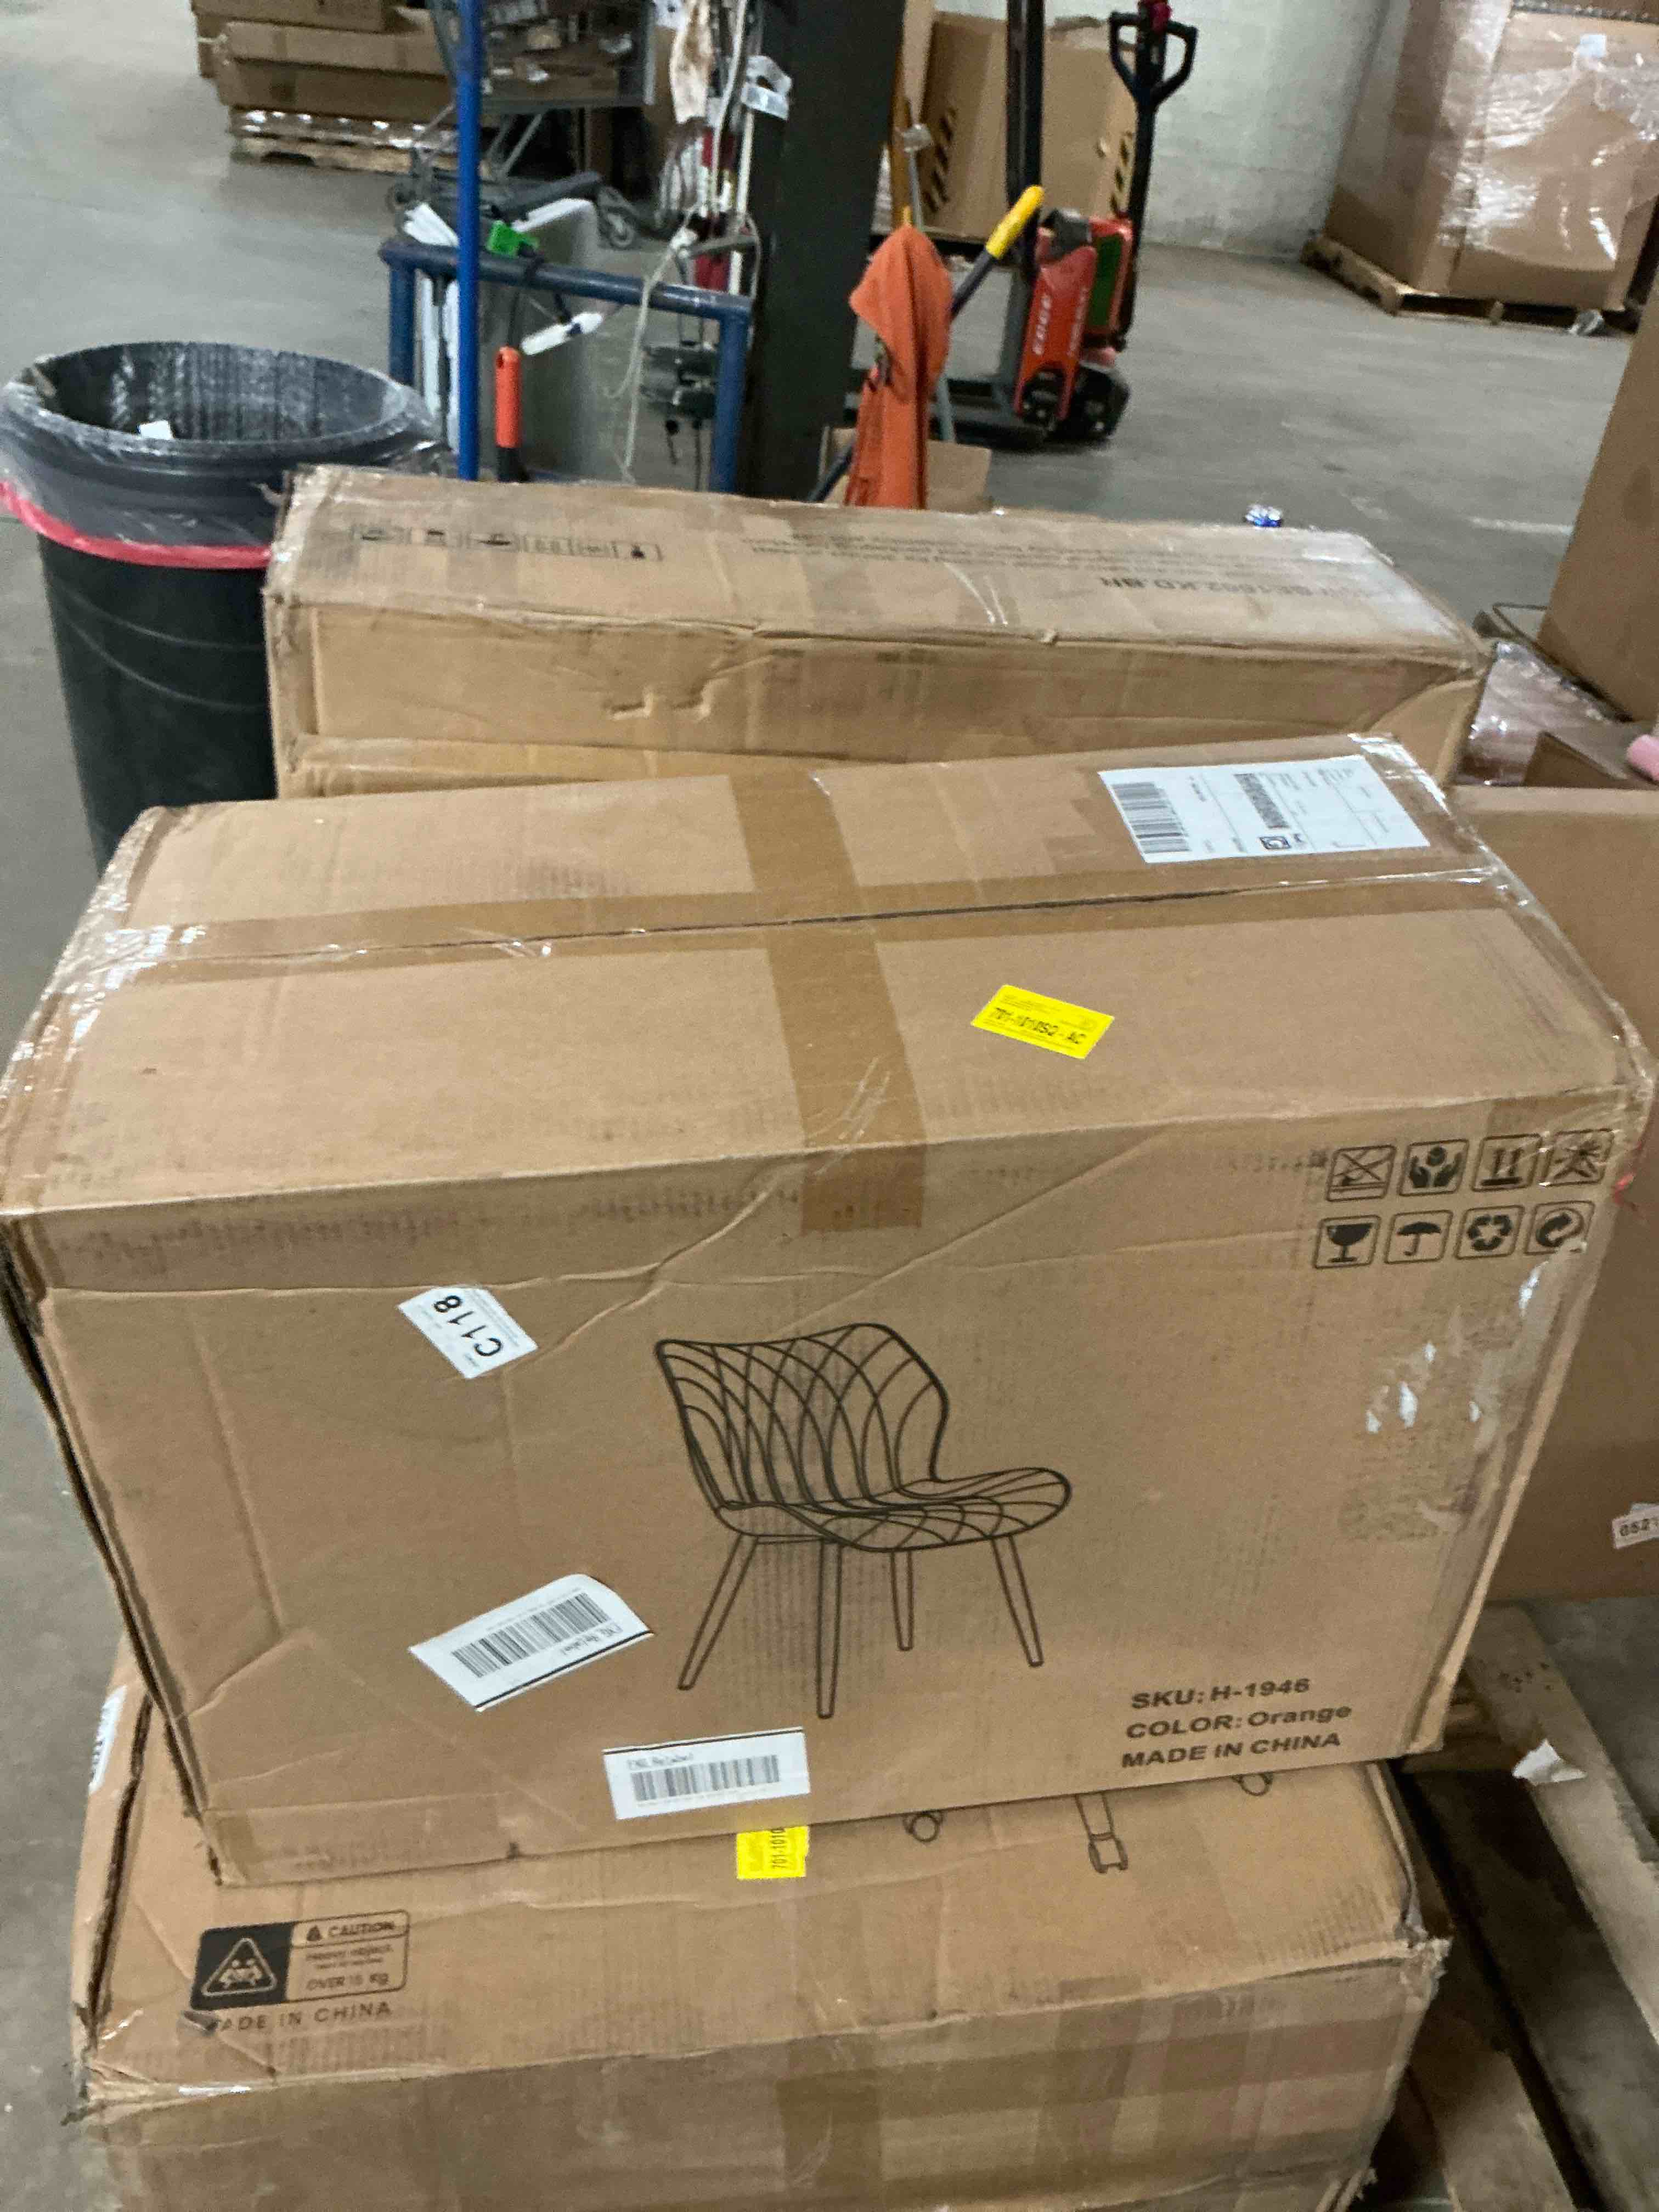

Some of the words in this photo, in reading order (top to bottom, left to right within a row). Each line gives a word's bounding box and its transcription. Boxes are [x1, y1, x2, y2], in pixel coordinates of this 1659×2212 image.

[433, 1295, 504, 1357] C118
[1132, 1688, 1205, 1708] SKU:
[1126, 1714, 1243, 1739] COLOR:
[1248, 1706, 1352, 1726] Orange
[1122, 1745, 1208, 1768] MADE
[1214, 1742, 1244, 1758] IN
[1250, 1733, 1340, 1754] CHINA
[215, 2015, 268, 2032] ADE
[280, 2012, 303, 2026] IN
[313, 2001, 392, 2023] CHINA
